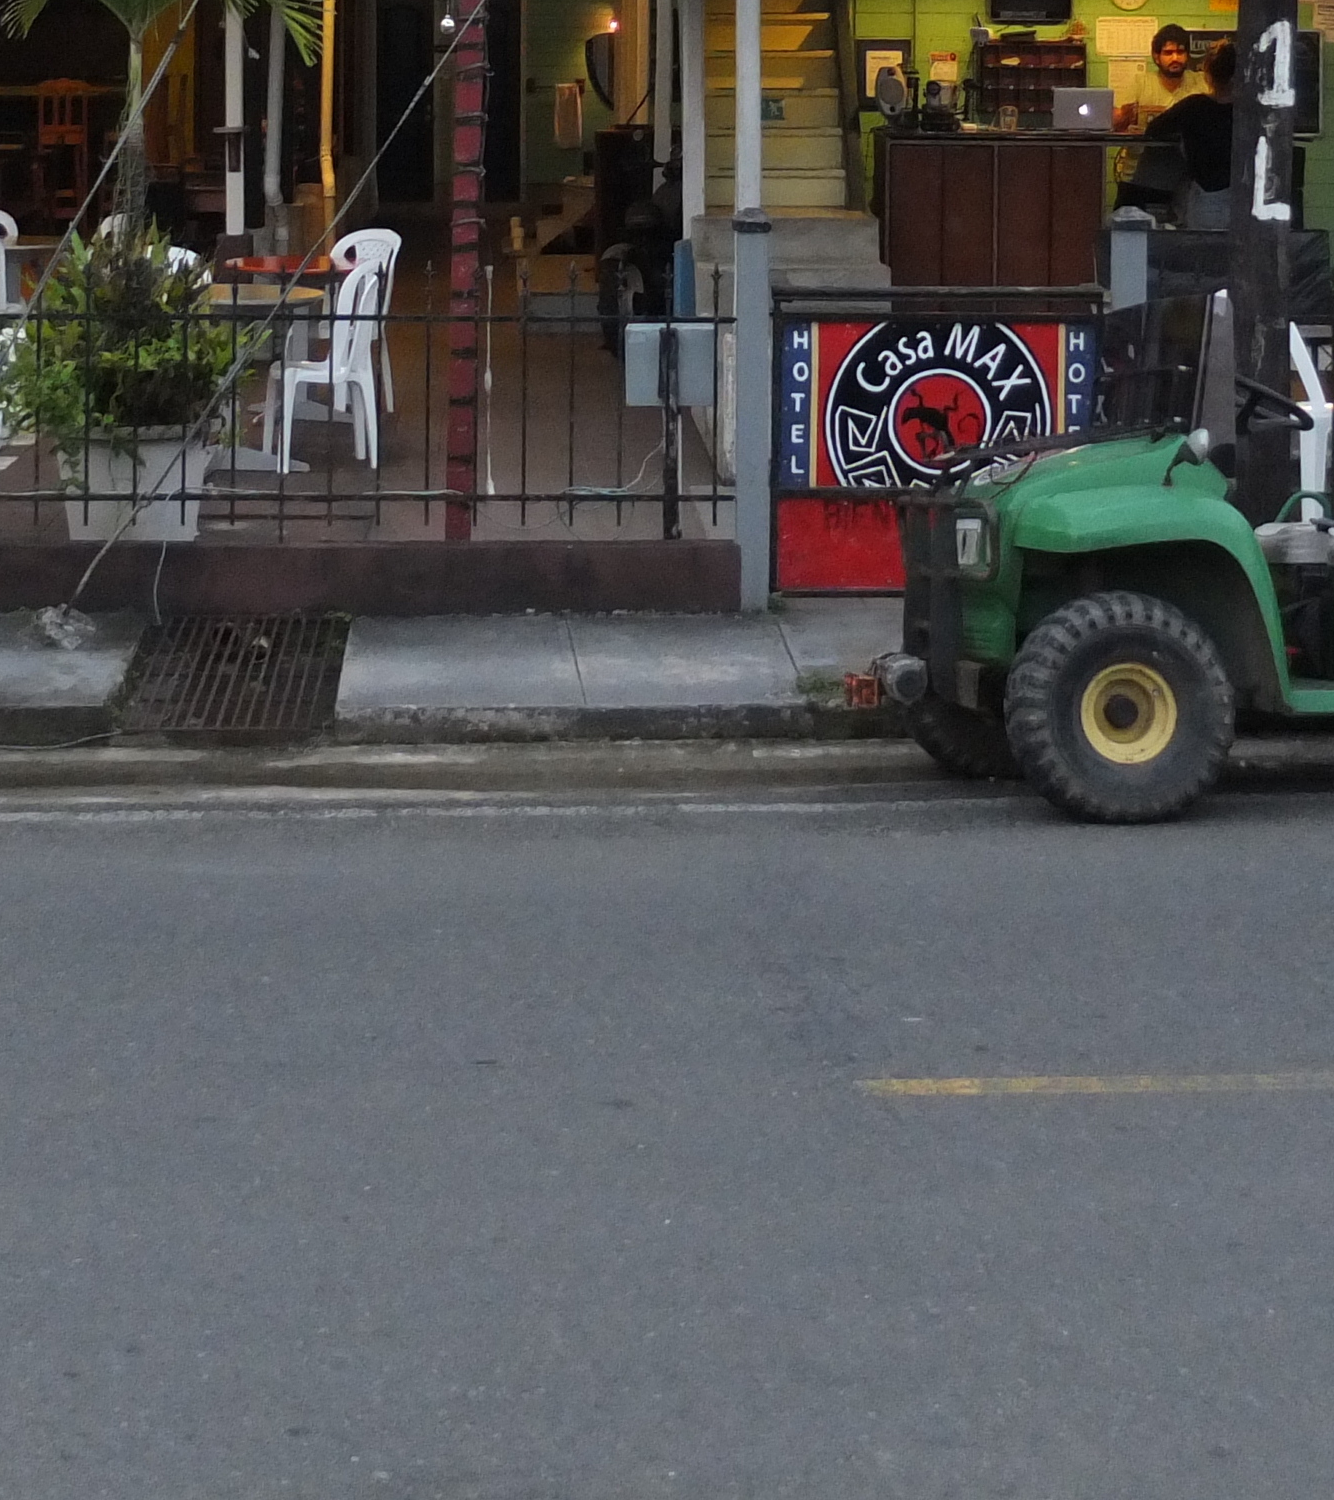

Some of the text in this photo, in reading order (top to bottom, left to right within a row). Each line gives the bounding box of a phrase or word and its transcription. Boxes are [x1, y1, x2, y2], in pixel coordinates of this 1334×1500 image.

[790, 330, 810, 475] HOTEL
[856, 323, 1031, 400] Casa MAX
[1067, 331, 1086, 433] HOT
